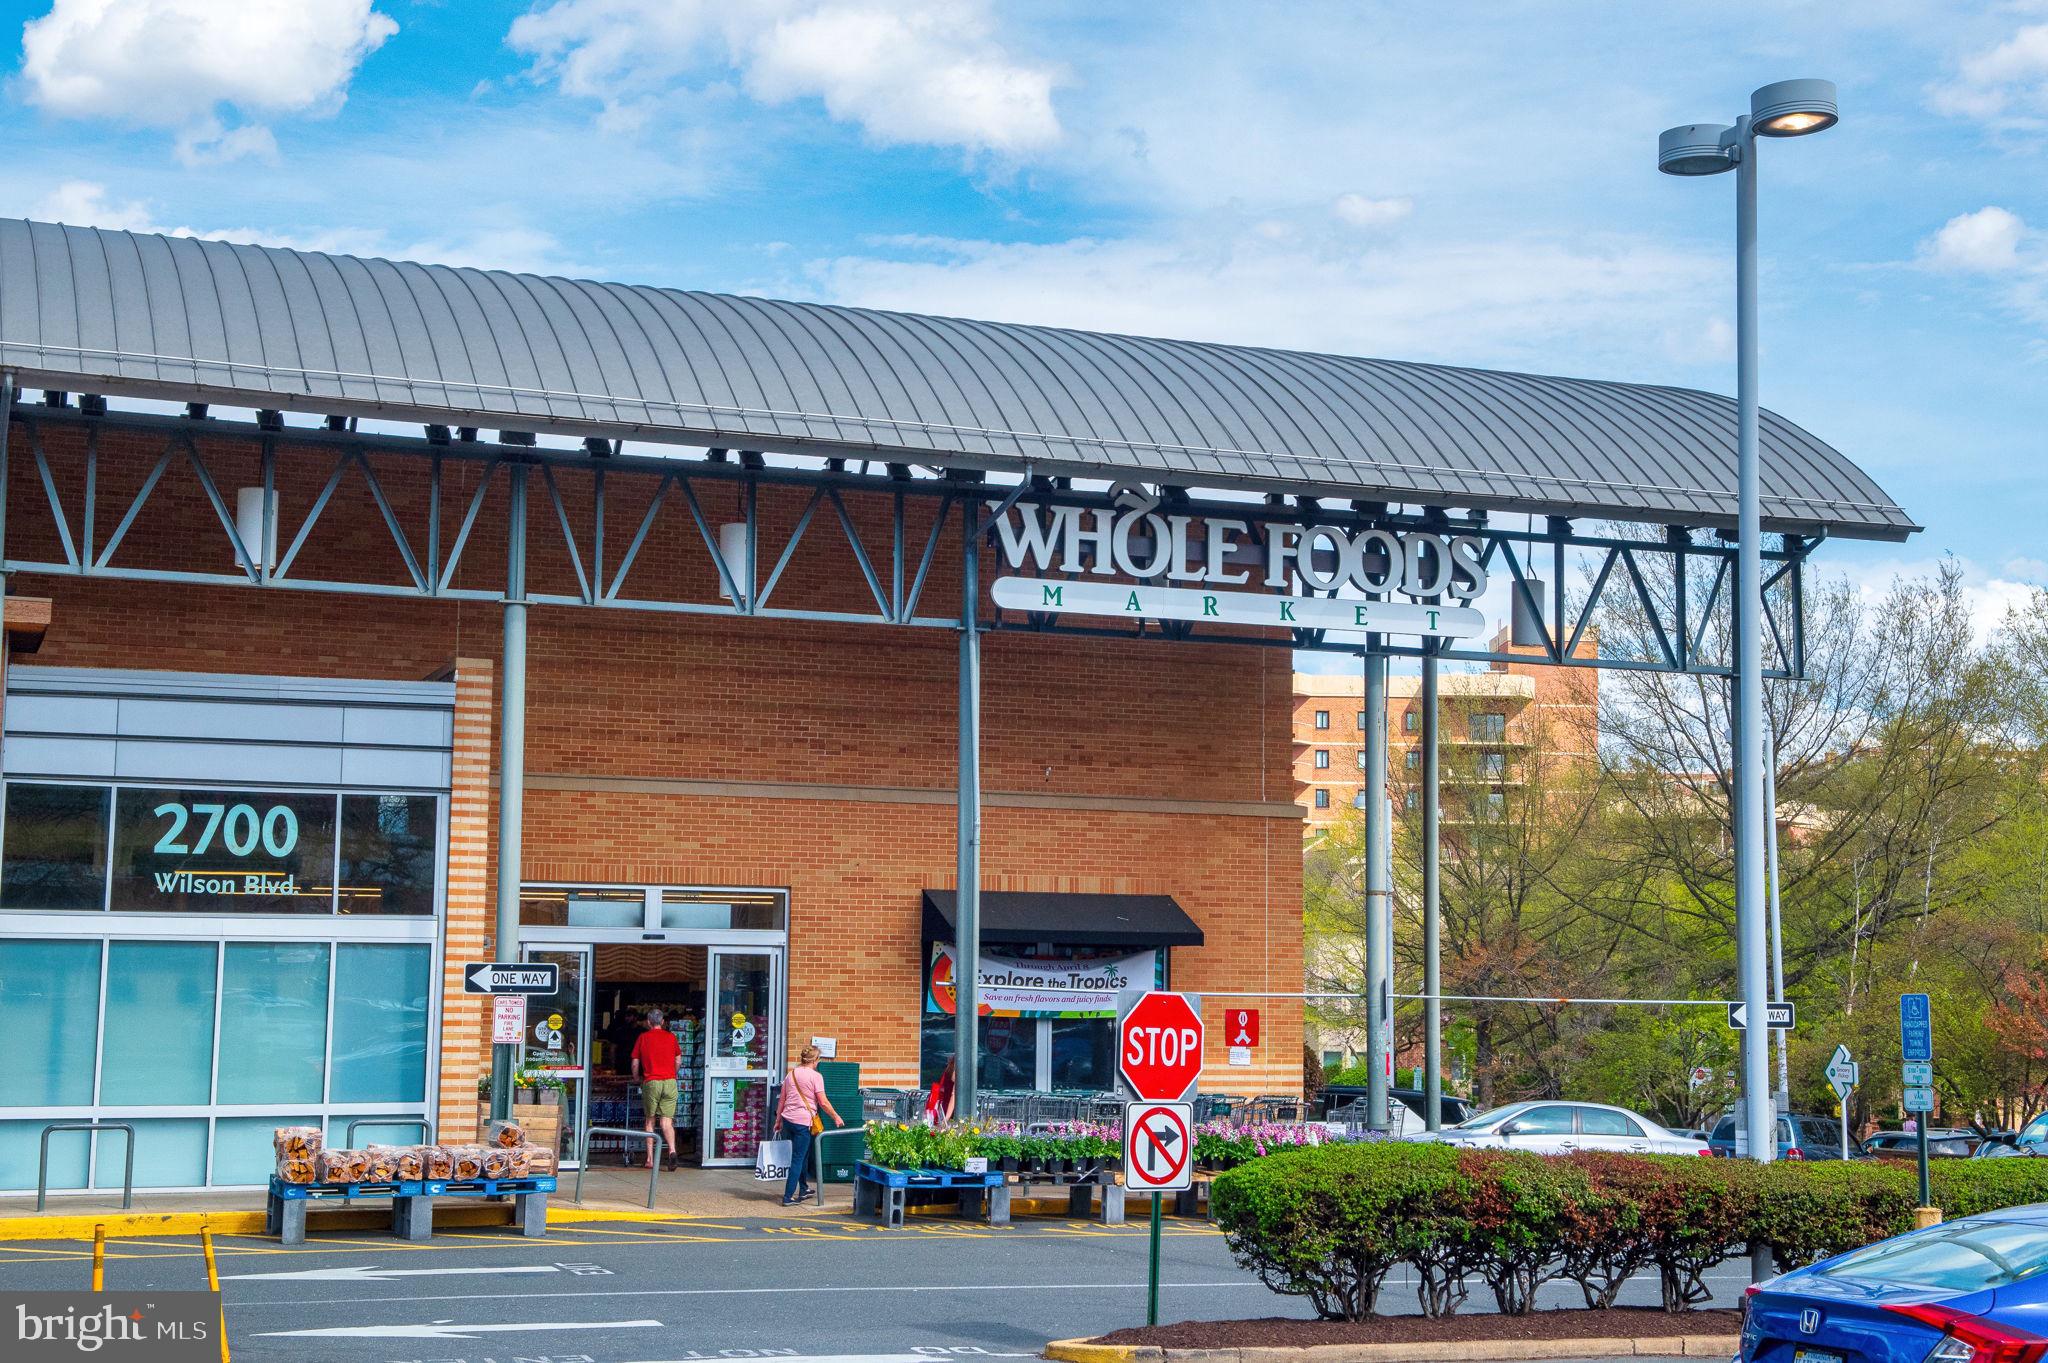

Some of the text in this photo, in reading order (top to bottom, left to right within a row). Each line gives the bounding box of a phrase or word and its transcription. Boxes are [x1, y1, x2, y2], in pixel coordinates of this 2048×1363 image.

[985, 481, 1488, 600] WHOLE FOODS
[1042, 585, 1442, 631] MARKET
[153, 802, 299, 858] 2700
[154, 872, 299, 896] Wilson Blvd.
[1016, 961, 1055, 971] Through
[492, 973, 547, 985] ONE WAY
[1047, 978, 1067, 988] the
[1067, 973, 1128, 989] Tropics
[984, 993, 1003, 1001] Save
[1014, 995, 1034, 1003] fresh
[1034, 995, 1060, 1003] flavors
[1076, 996, 1094, 1005] juicy
[1768, 1011, 1787, 1020] WAY
[1127, 1027, 1198, 1067] STOP
